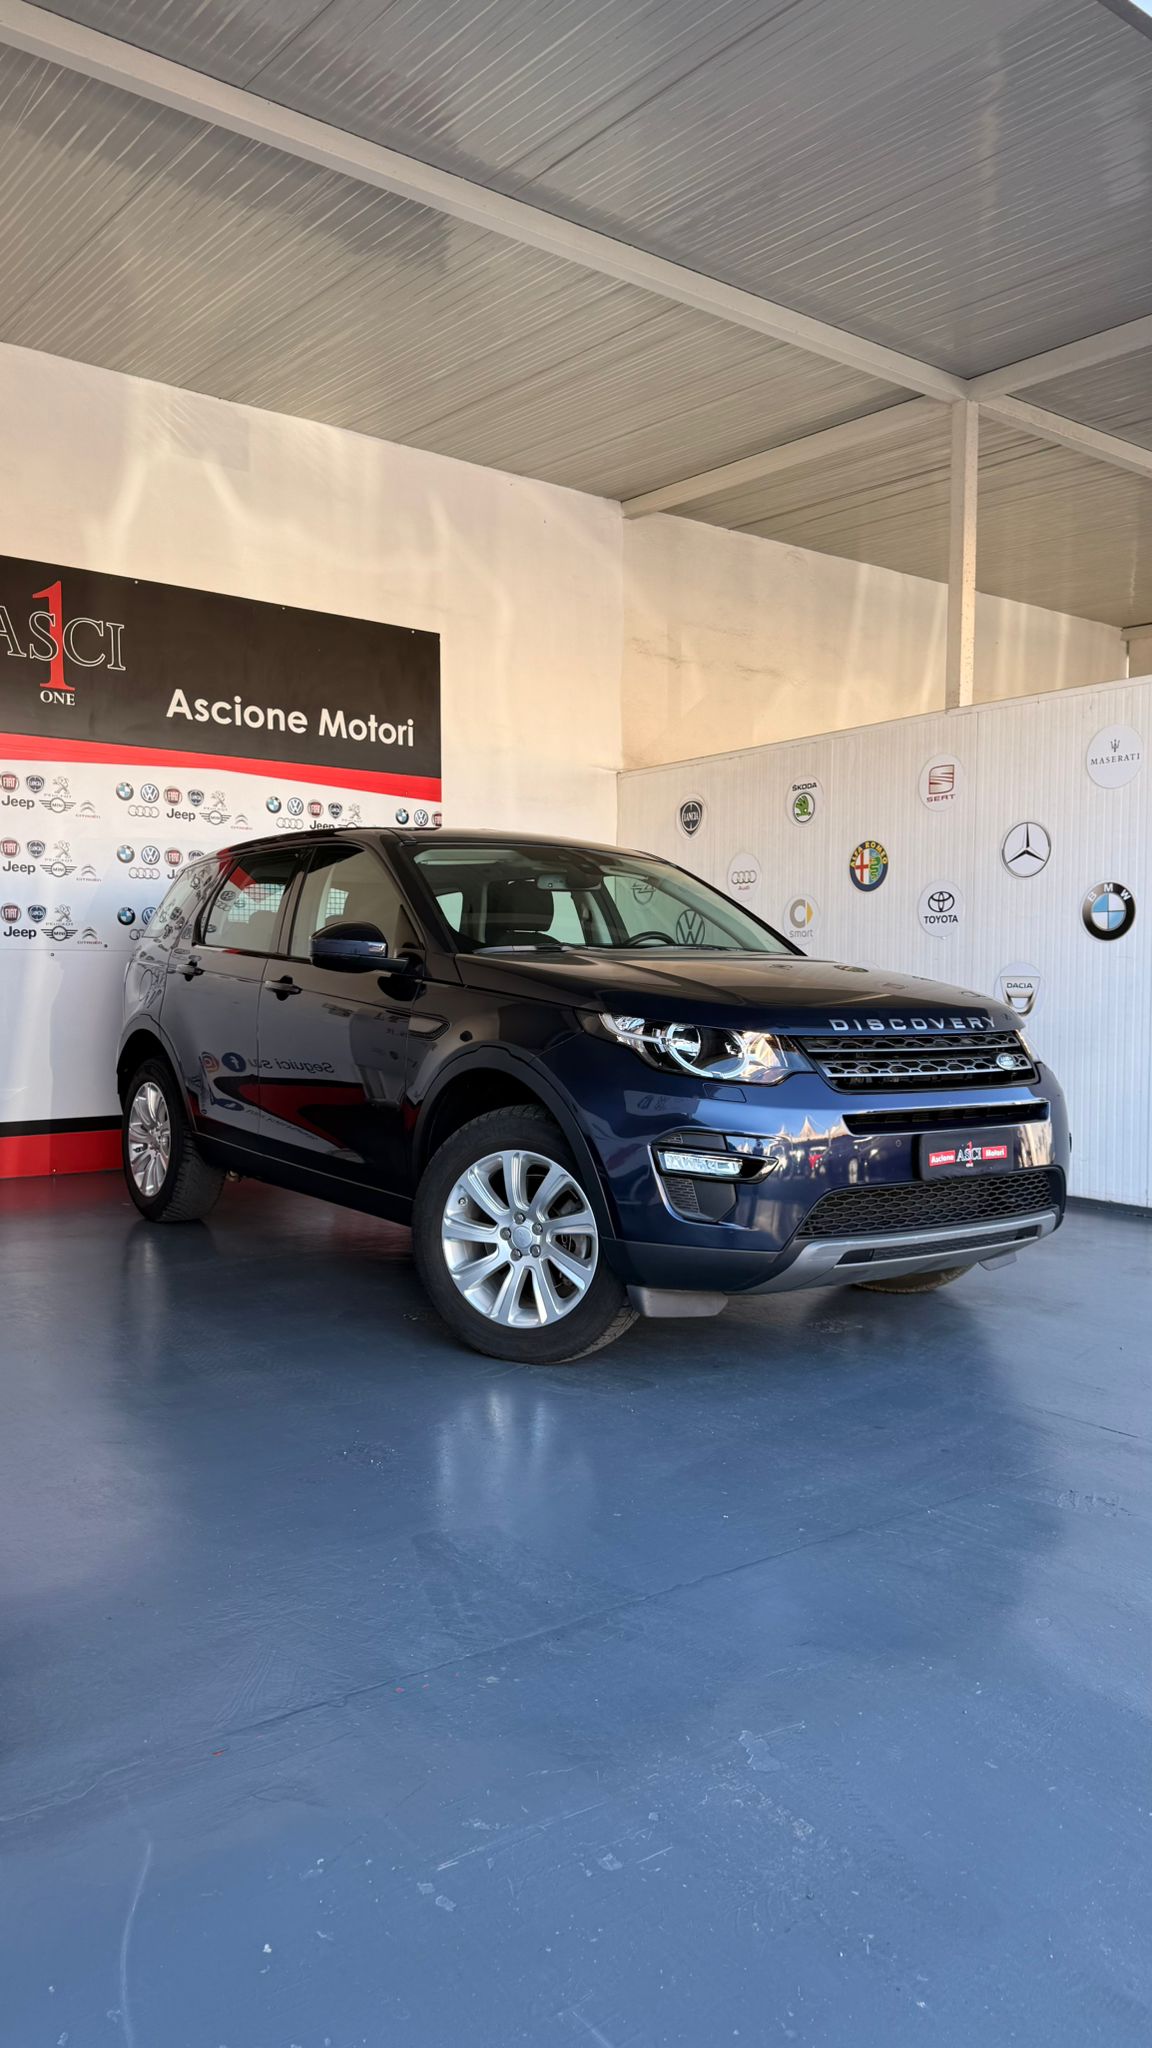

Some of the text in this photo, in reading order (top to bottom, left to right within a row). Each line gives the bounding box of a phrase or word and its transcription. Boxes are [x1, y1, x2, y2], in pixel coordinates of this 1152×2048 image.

[40, 690, 75, 706] ONE
[166, 688, 414, 748] Ascione Motori
[1090, 752, 1141, 766] MASERATI
[792, 782, 818, 792] ŠKODA
[1, 795, 35, 810] Jeep
[926, 794, 956, 803] SEAT
[167, 808, 196, 822] Jeep
[864, 841, 888, 865] ROMEO
[3, 861, 36, 875] Jeep
[924, 914, 959, 925] TOYOTA
[3, 926, 37, 940] Jeep
[789, 928, 814, 938] smart
[828, 1016, 996, 1031] DISCOVERY
[931, 1147, 1005, 1164] Ascione ASCI Motori
